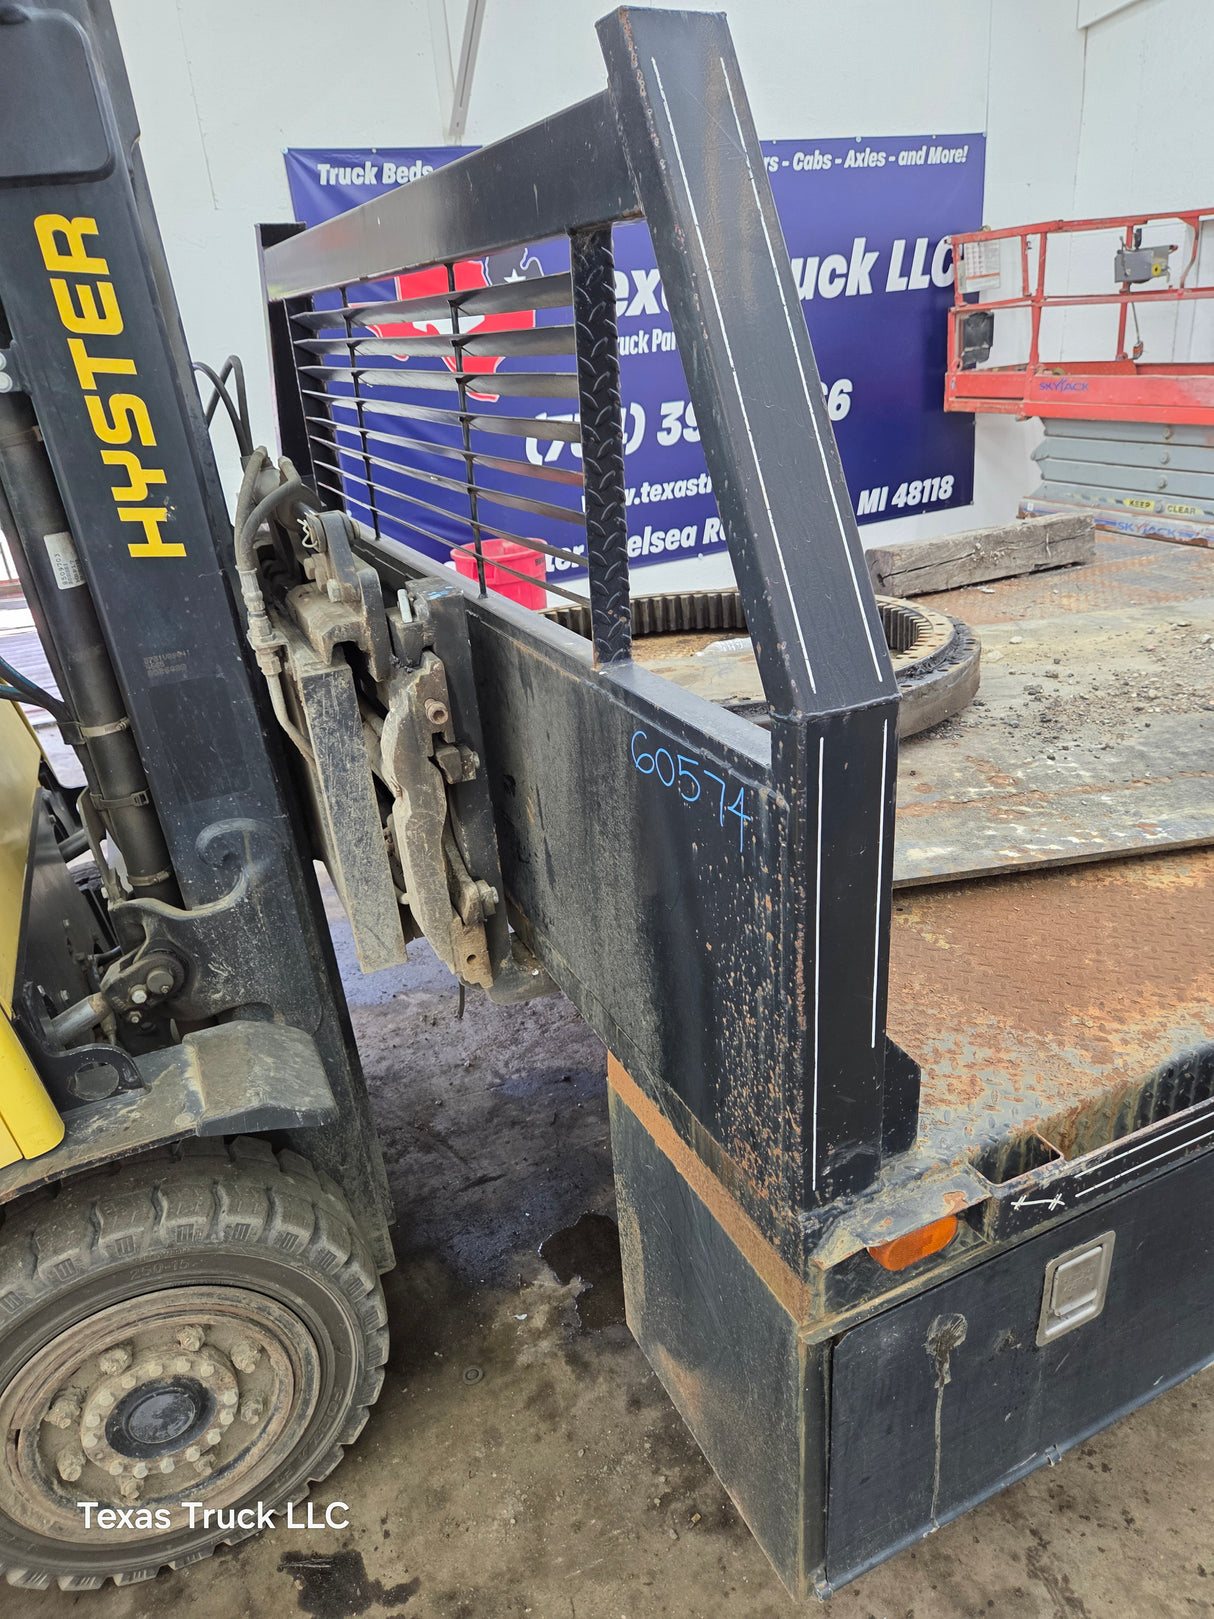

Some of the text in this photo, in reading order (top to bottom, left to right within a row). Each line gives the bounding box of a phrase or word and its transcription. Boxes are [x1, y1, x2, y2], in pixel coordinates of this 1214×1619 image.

[317, 161, 379, 185] Truck
[792, 150, 832, 171] Cabs
[844, 147, 887, 169] Axles
[898, 145, 927, 166] and
[927, 145, 969, 163] More!
[613, 268, 670, 318] ex
[885, 235, 955, 293] LLC
[33, 212, 188, 558] HYSTER
[856, 486, 889, 516] MI
[891, 474, 955, 508] 48118
[1129, 498, 1197, 515] KEEP CLEAR
[631, 730, 752, 853] 60574
